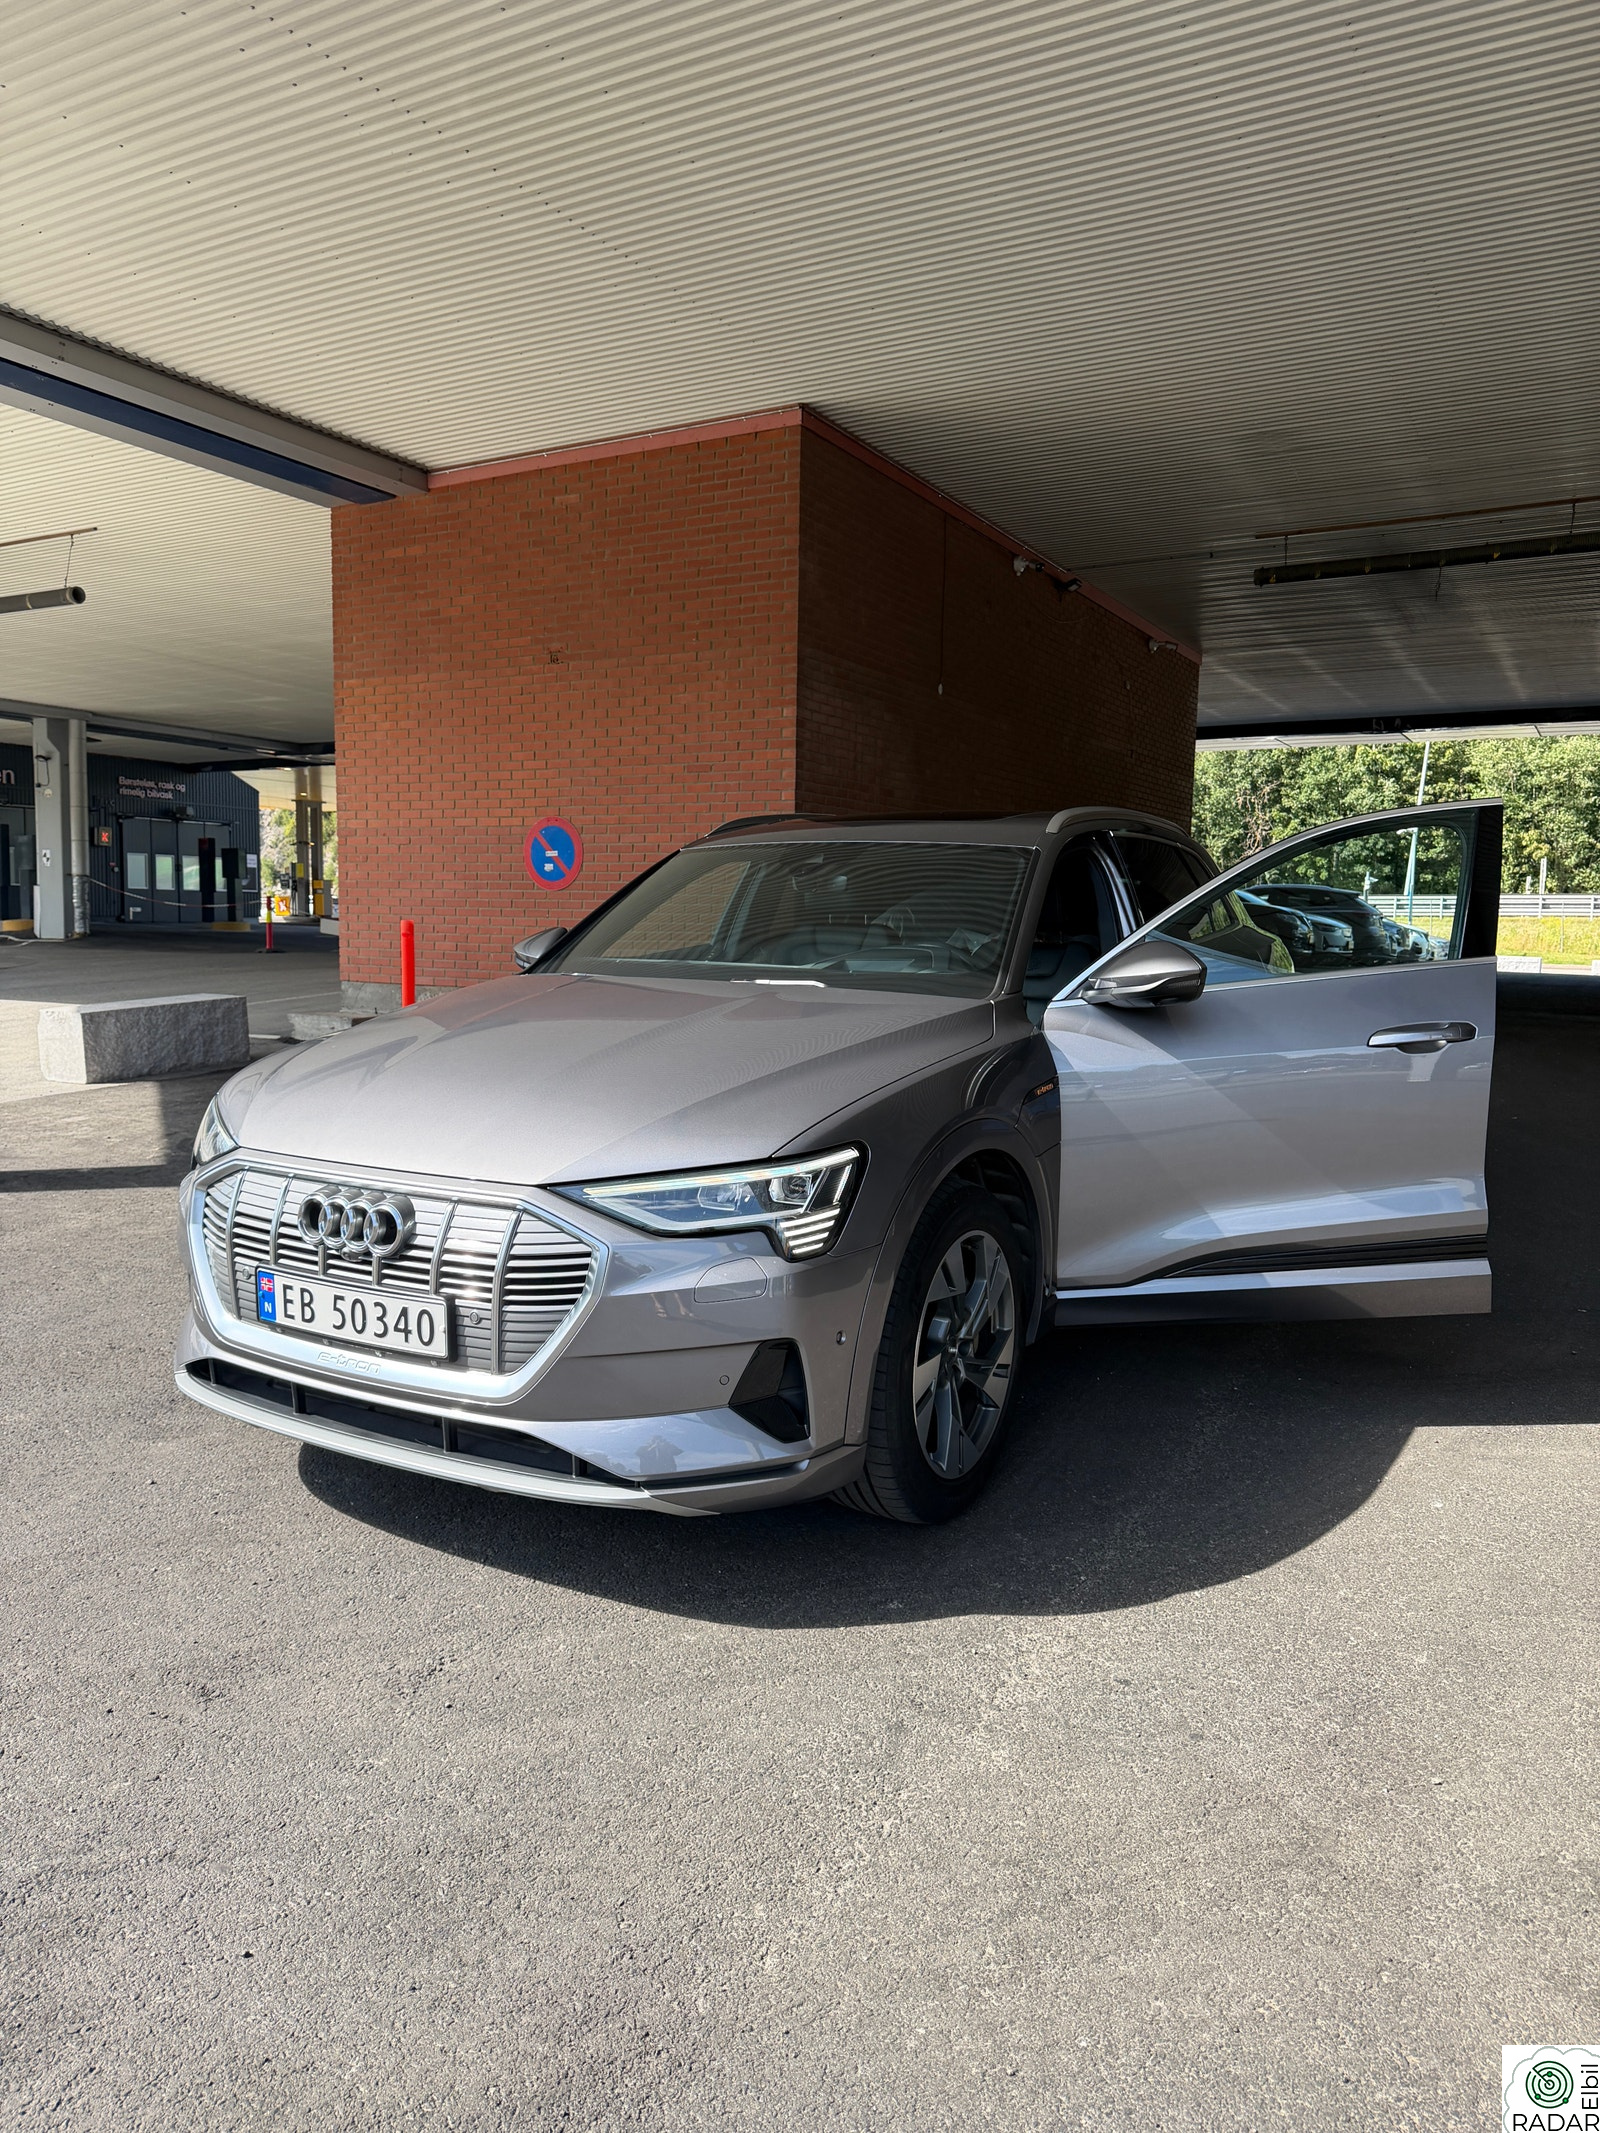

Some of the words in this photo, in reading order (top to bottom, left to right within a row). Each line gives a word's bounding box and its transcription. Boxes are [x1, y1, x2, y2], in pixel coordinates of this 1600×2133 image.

[0, 769, 15, 785] n
[119, 786, 146, 799] rimelig
[147, 789, 173, 800] bilvask
[158, 780, 175, 790] rask
[175, 783, 186, 792] og
[264, 1301, 273, 1314] N
[283, 1283, 315, 1324] EB
[332, 1294, 435, 1347] 50340
[317, 1351, 382, 1375] e-tron
